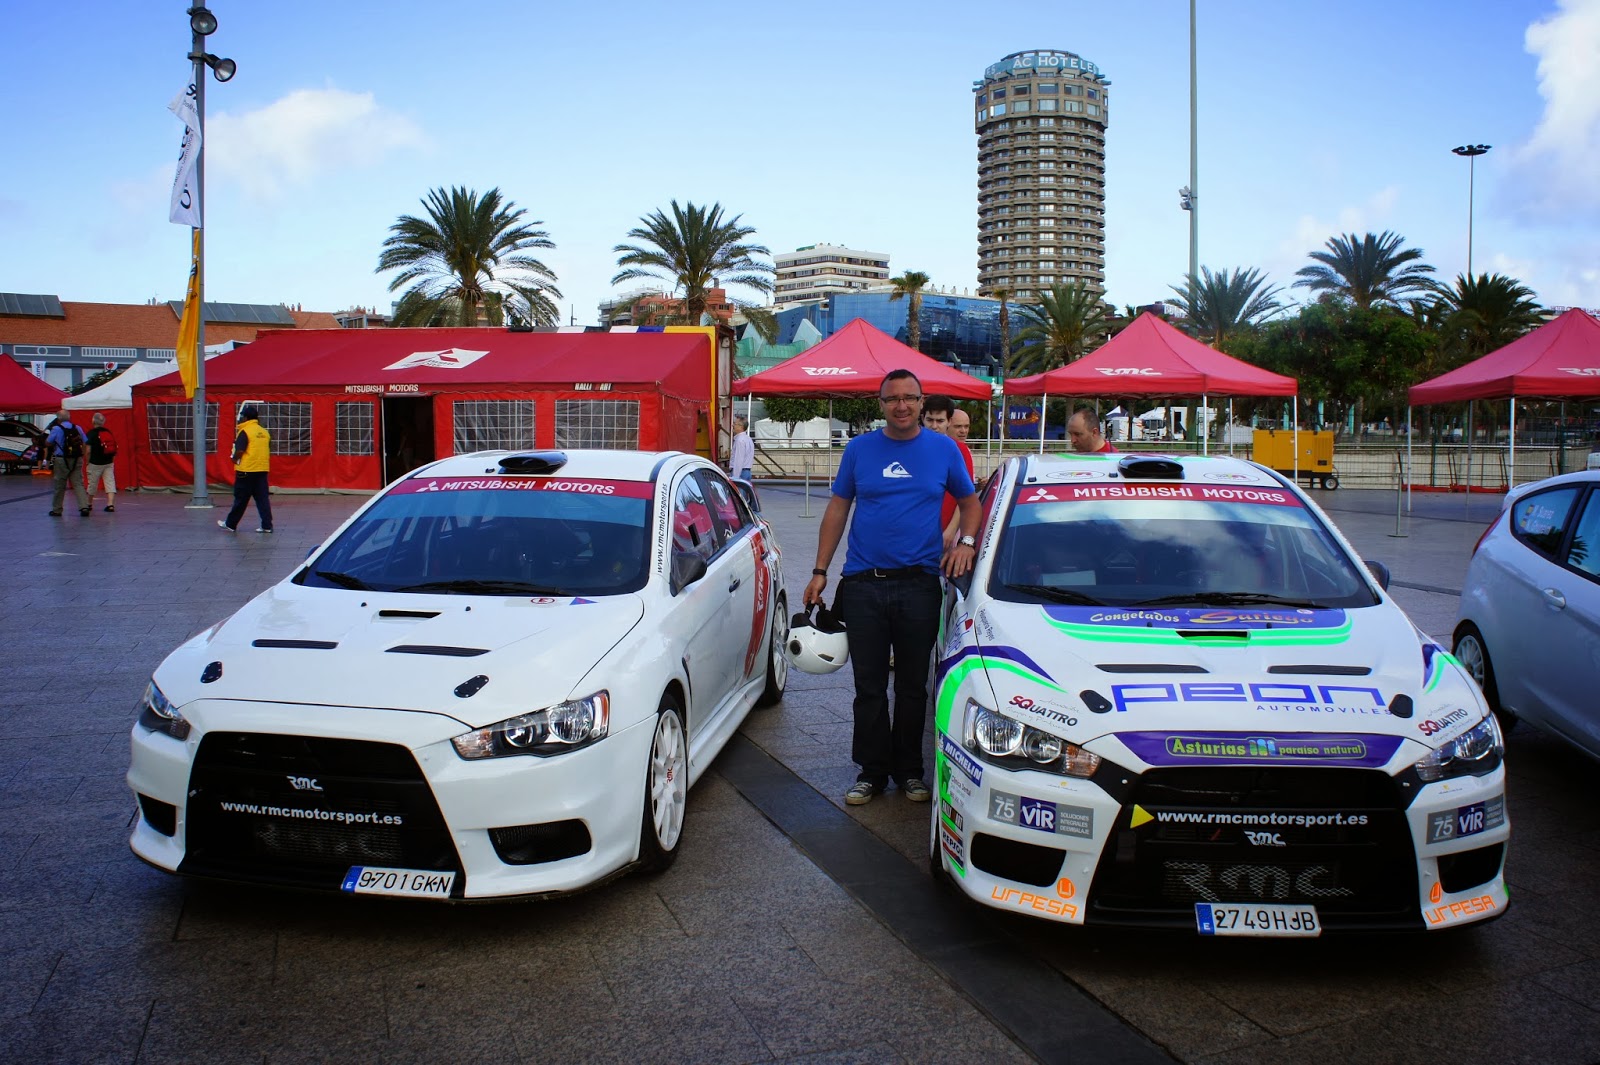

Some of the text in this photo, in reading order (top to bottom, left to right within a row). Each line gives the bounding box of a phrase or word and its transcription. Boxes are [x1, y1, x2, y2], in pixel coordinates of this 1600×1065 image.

[1013, 56, 1098, 73] AC HOTELES
[345, 384, 419, 393] MITSUBISHI MOTORS
[998, 411, 1027, 420] FNIX
[441, 480, 615, 495] MITSUBISHI MOTORS
[1073, 487, 1286, 503] MITSUBISHI MOTORS
[656, 483, 668, 574] www.rmcmotorsport.es
[1090, 610, 1180, 623] Congelados
[1008, 695, 1078, 727] SQUATTRO
[1256, 704, 1393, 716] AUTOMOVILES
[1418, 708, 1468, 736] SQUATTRO
[1172, 738, 1246, 756] Asturias
[1323, 744, 1362, 755] natural
[945, 743, 982, 780] MICHELIN
[220, 801, 402, 825] www.rmcmotorsport.es
[995, 799, 1015, 819] 75
[1060, 812, 1089, 820] SOLUCIONES
[1060, 819, 1088, 828] INTEGRALES
[1157, 810, 1368, 828] www.rmcmotorsport.es
[1434, 818, 1453, 837] 75
[943, 831, 963, 858] REPSOL
[345, 881, 352, 889] E
[1203, 922, 1210, 930] E
